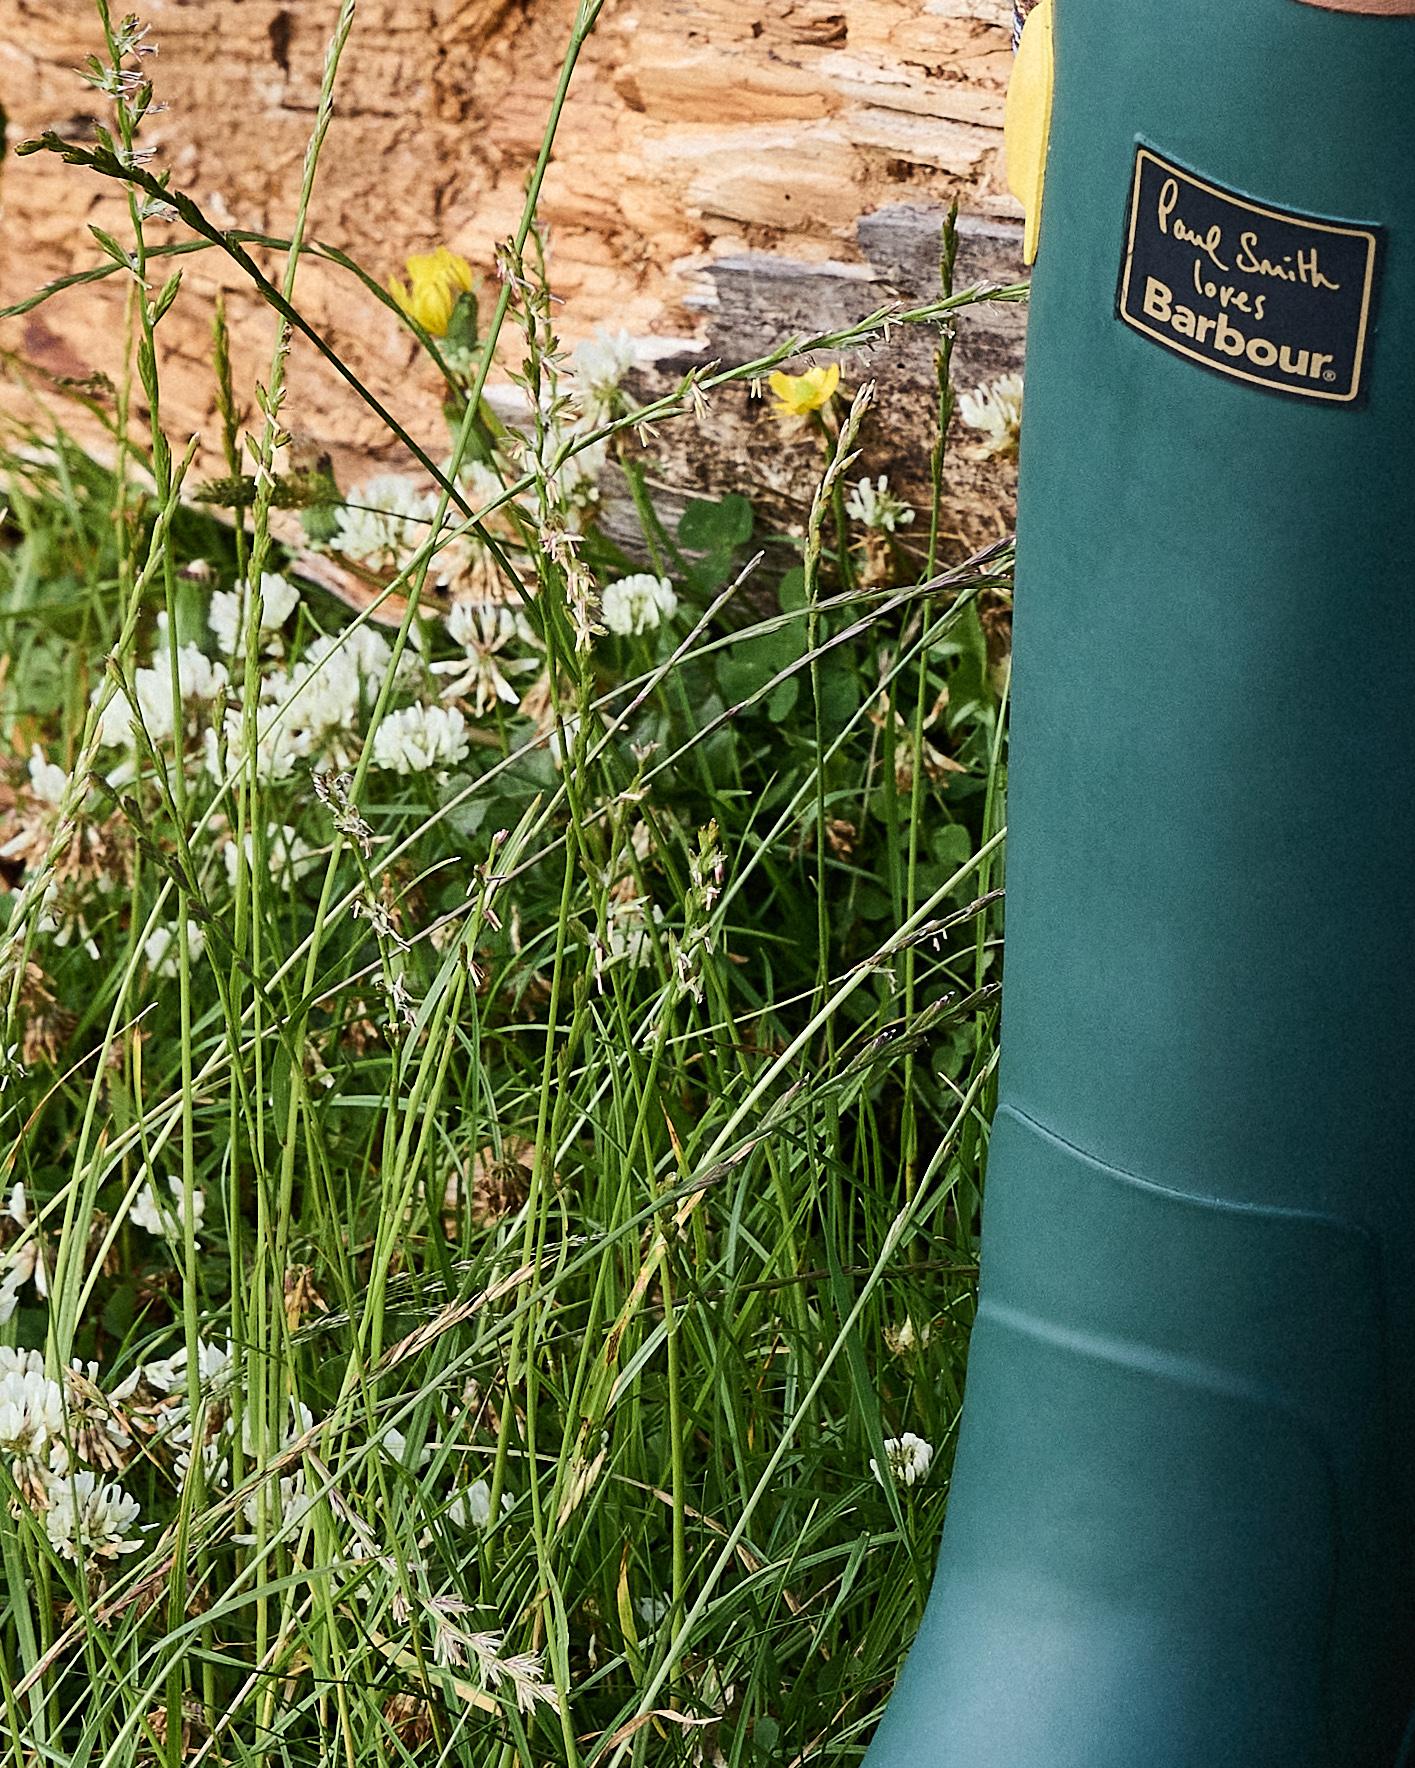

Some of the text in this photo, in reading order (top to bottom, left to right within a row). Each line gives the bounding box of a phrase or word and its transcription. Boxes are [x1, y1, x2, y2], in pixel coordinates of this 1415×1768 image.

[1158, 178, 1340, 290] Paul Smith
[1194, 259, 1266, 320] loves
